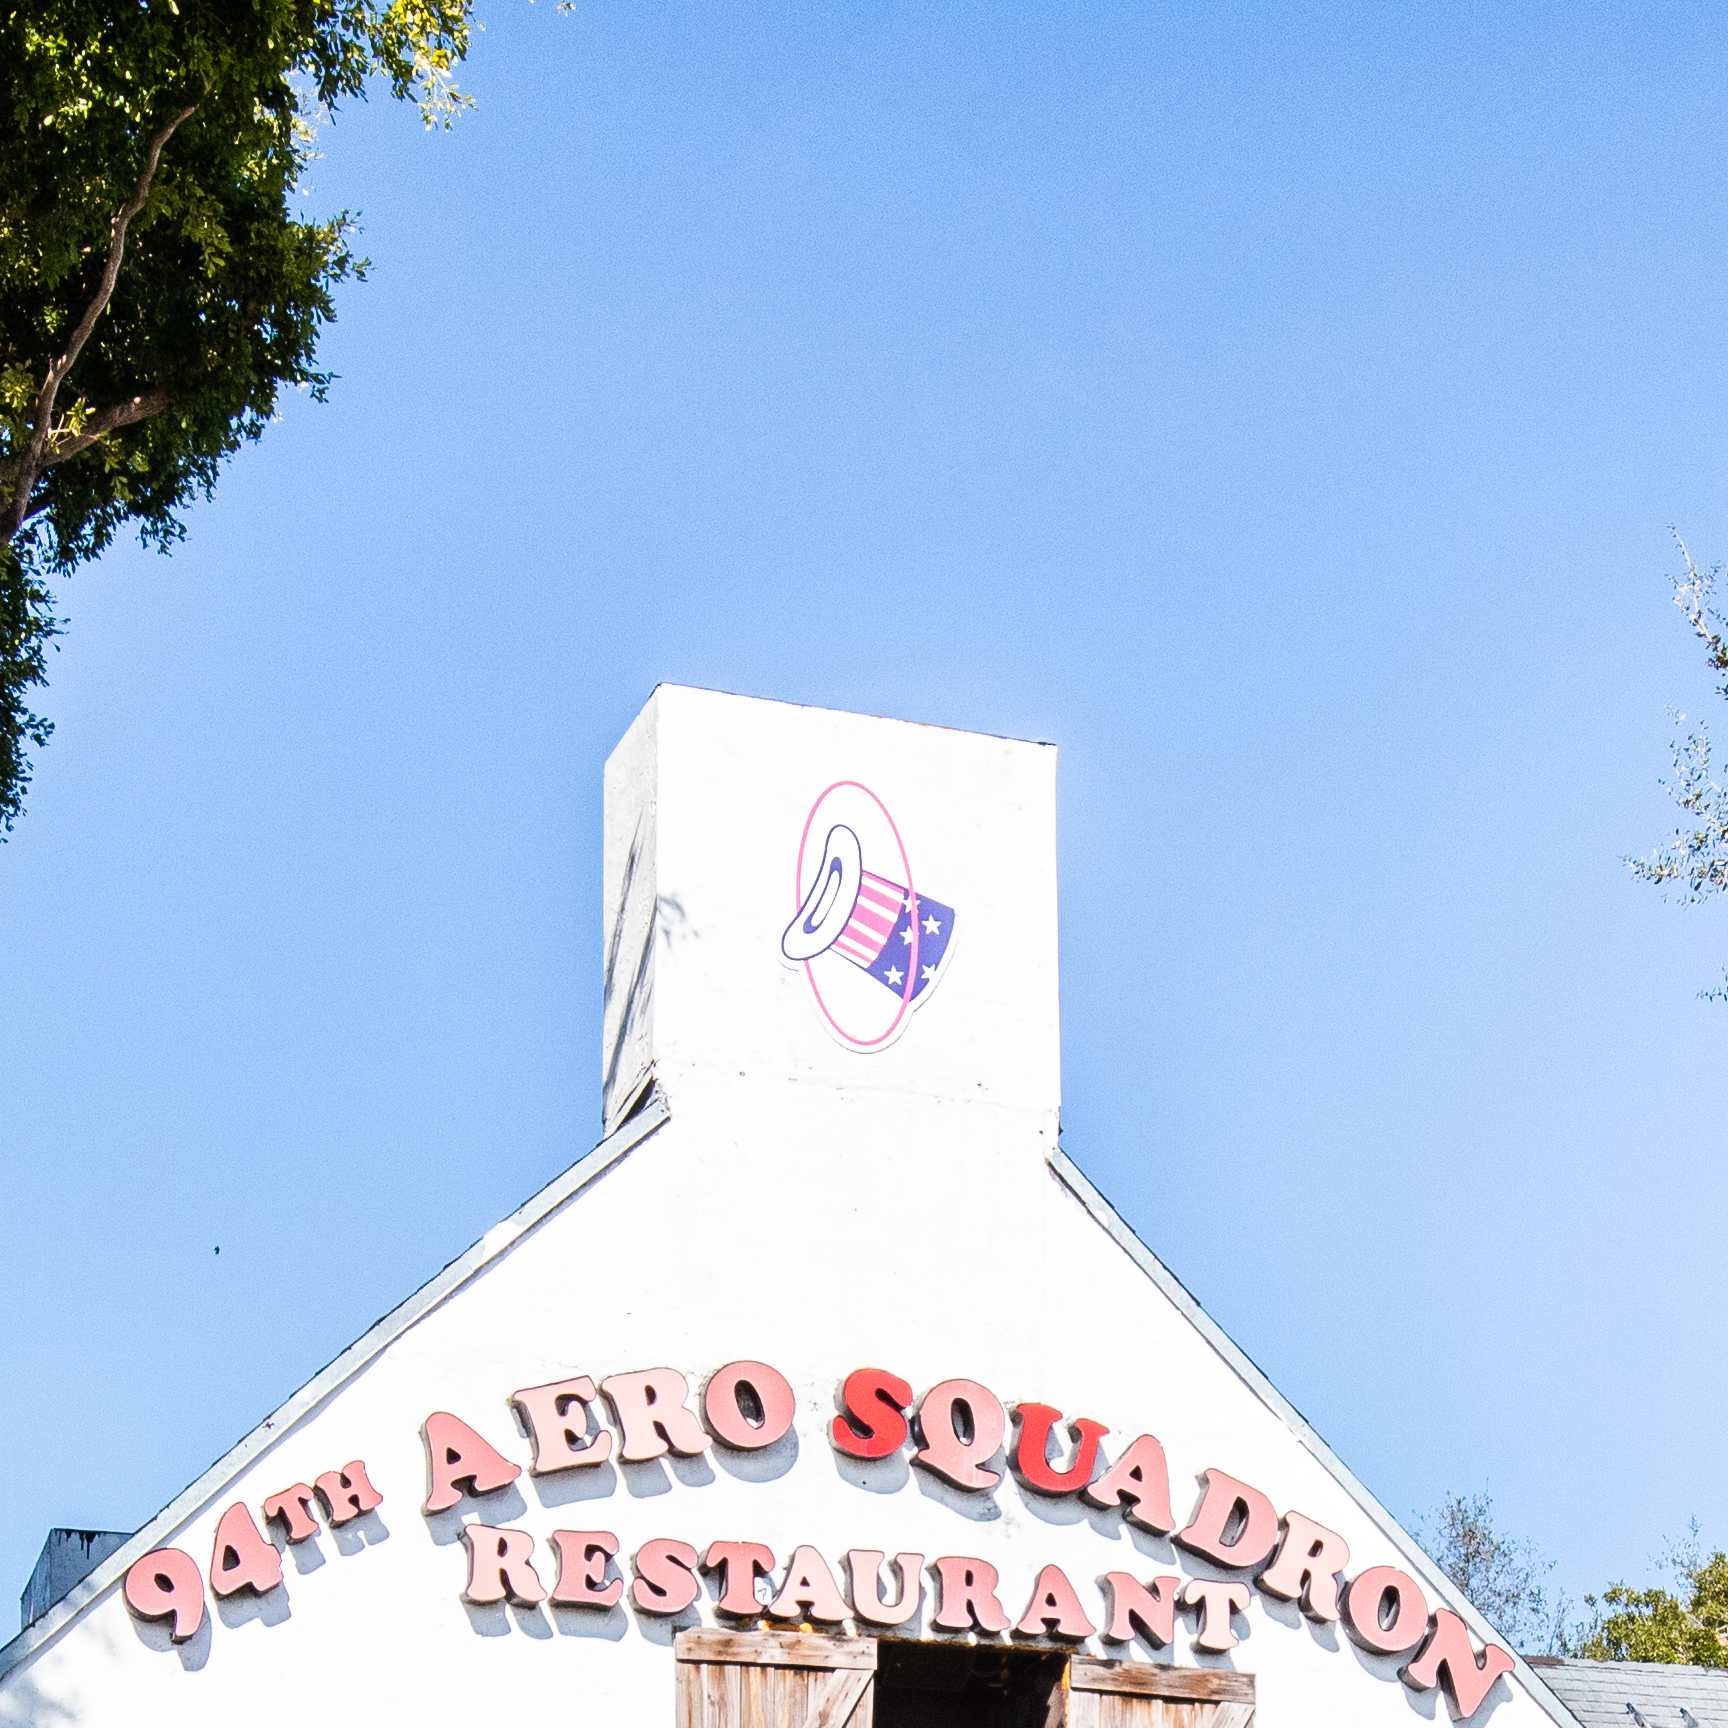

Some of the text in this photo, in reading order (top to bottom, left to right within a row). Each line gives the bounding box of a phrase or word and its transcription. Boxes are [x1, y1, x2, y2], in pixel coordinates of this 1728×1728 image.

[124, 1360, 1515, 1719] 94TH AERO SQUADRON
[464, 1524, 1251, 1652] RESTAURANT
